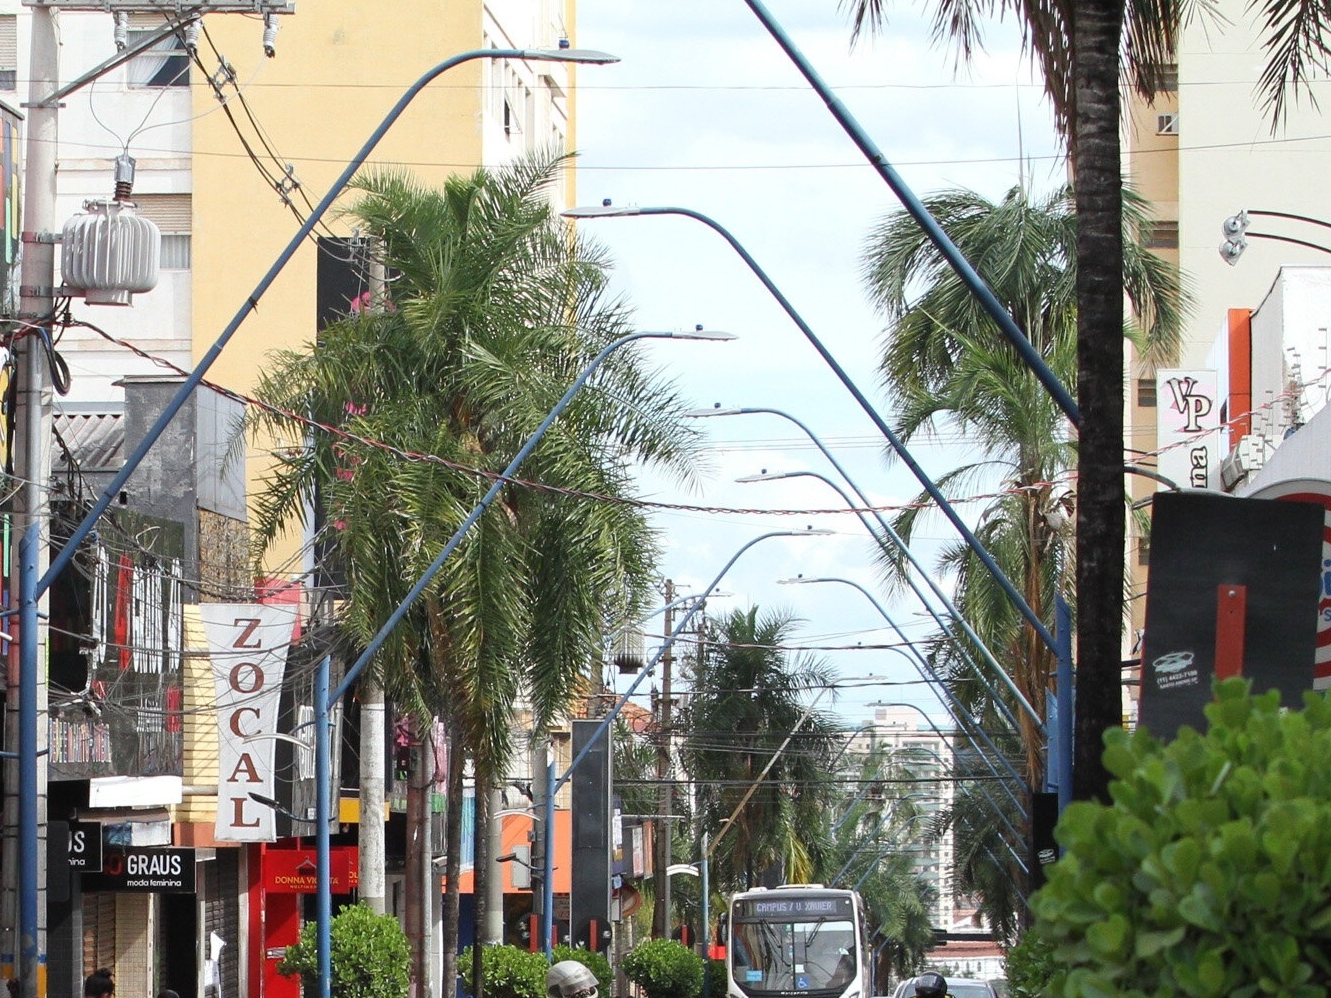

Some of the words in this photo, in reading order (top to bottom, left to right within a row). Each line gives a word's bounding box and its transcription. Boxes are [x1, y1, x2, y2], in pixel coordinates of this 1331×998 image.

[1166, 377, 1213, 433] VP
[226, 618, 265, 829] ZOCAL
[127, 854, 182, 876] GRAUS
[127, 879, 149, 887] moda
[149, 879, 182, 887] feminina
[274, 876, 305, 884] DONNA
[756, 902, 787, 912] CAMPUS
